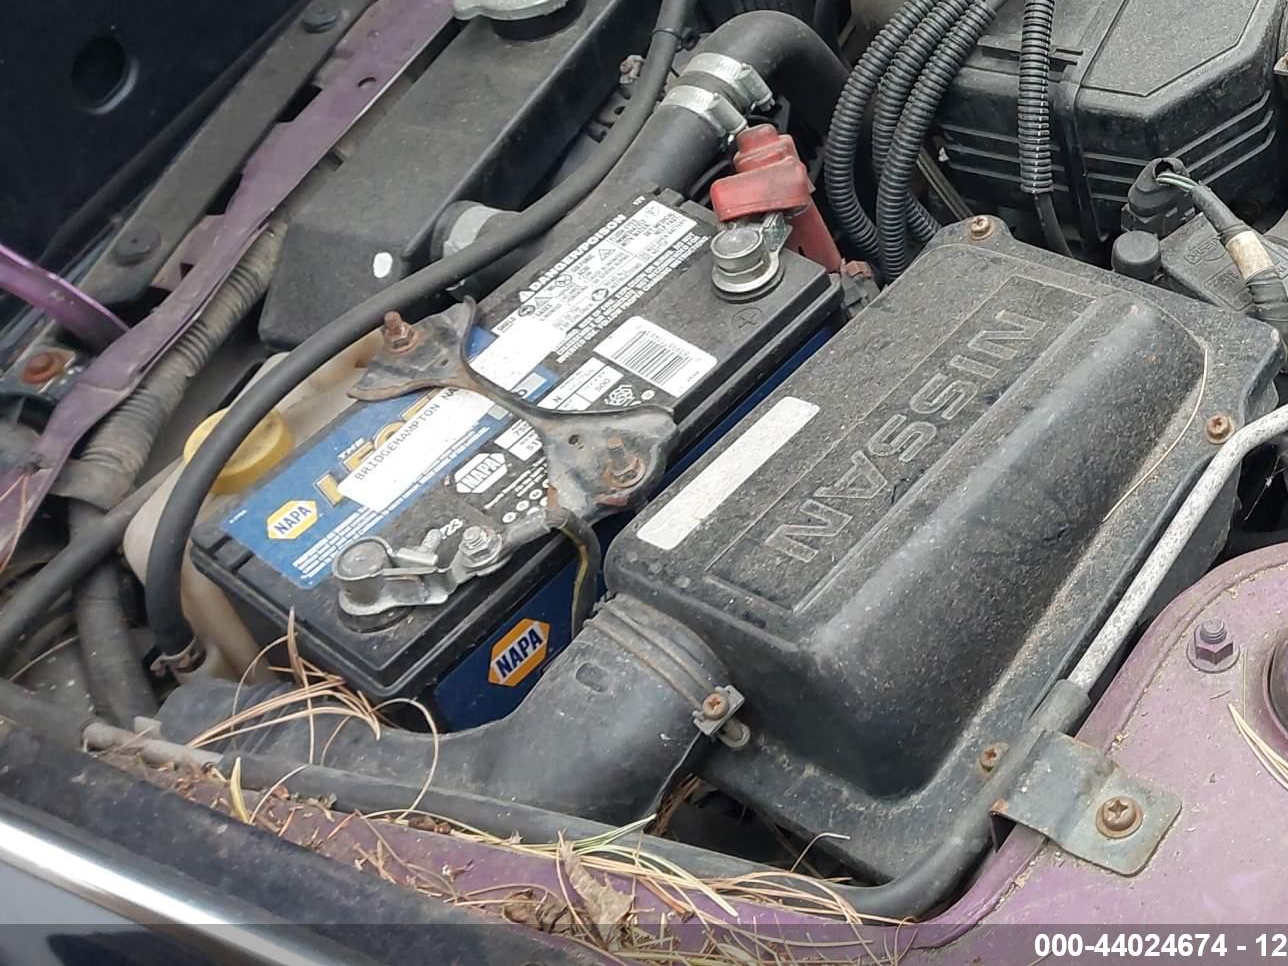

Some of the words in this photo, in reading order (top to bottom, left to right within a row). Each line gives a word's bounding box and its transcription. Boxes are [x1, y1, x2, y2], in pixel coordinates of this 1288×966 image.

[530, 213, 626, 292] DANGER/POISON
[354, 403, 440, 481] BRIDGEHAMPTON
[764, 309, 1047, 564] NISSAN
[460, 456, 501, 489] NAPA
[273, 505, 312, 534] NAPA
[494, 627, 543, 678] NAPA
